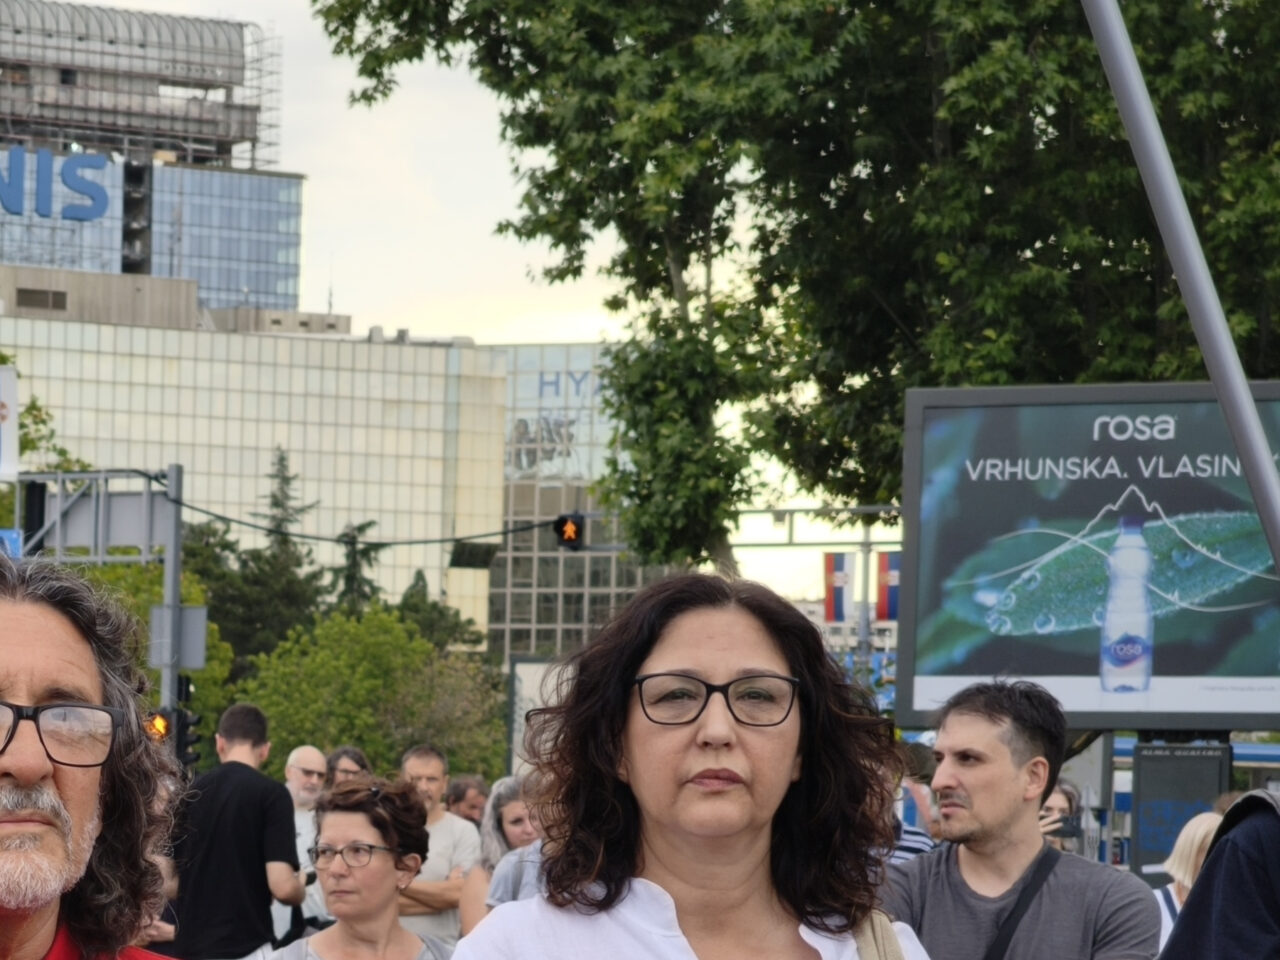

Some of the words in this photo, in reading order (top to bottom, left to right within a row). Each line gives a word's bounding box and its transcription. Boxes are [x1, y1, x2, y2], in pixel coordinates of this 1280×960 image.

[1093, 414, 1175, 441] rosa
[965, 455, 1128, 481] VRHUNSKA.
[1137, 453, 1241, 479] VLASIN
